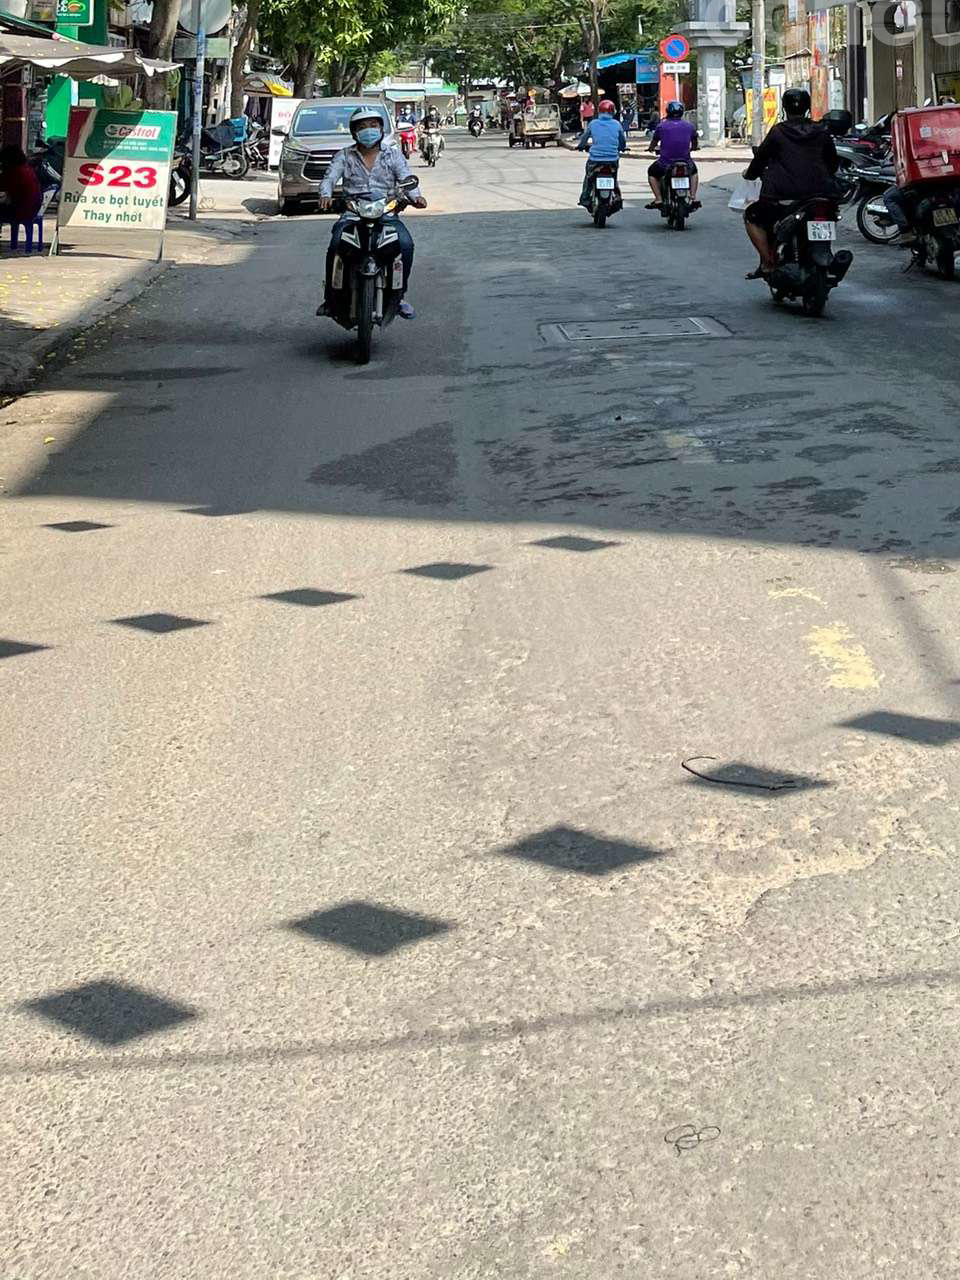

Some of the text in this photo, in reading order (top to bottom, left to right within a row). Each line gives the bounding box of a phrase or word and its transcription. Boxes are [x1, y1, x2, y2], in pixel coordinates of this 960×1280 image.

[118, 126, 156, 137] Castrol
[78, 163, 158, 189] S23
[92, 195, 105, 205] xe
[109, 195, 129, 207] bọt
[83, 210, 111, 223] Thay
